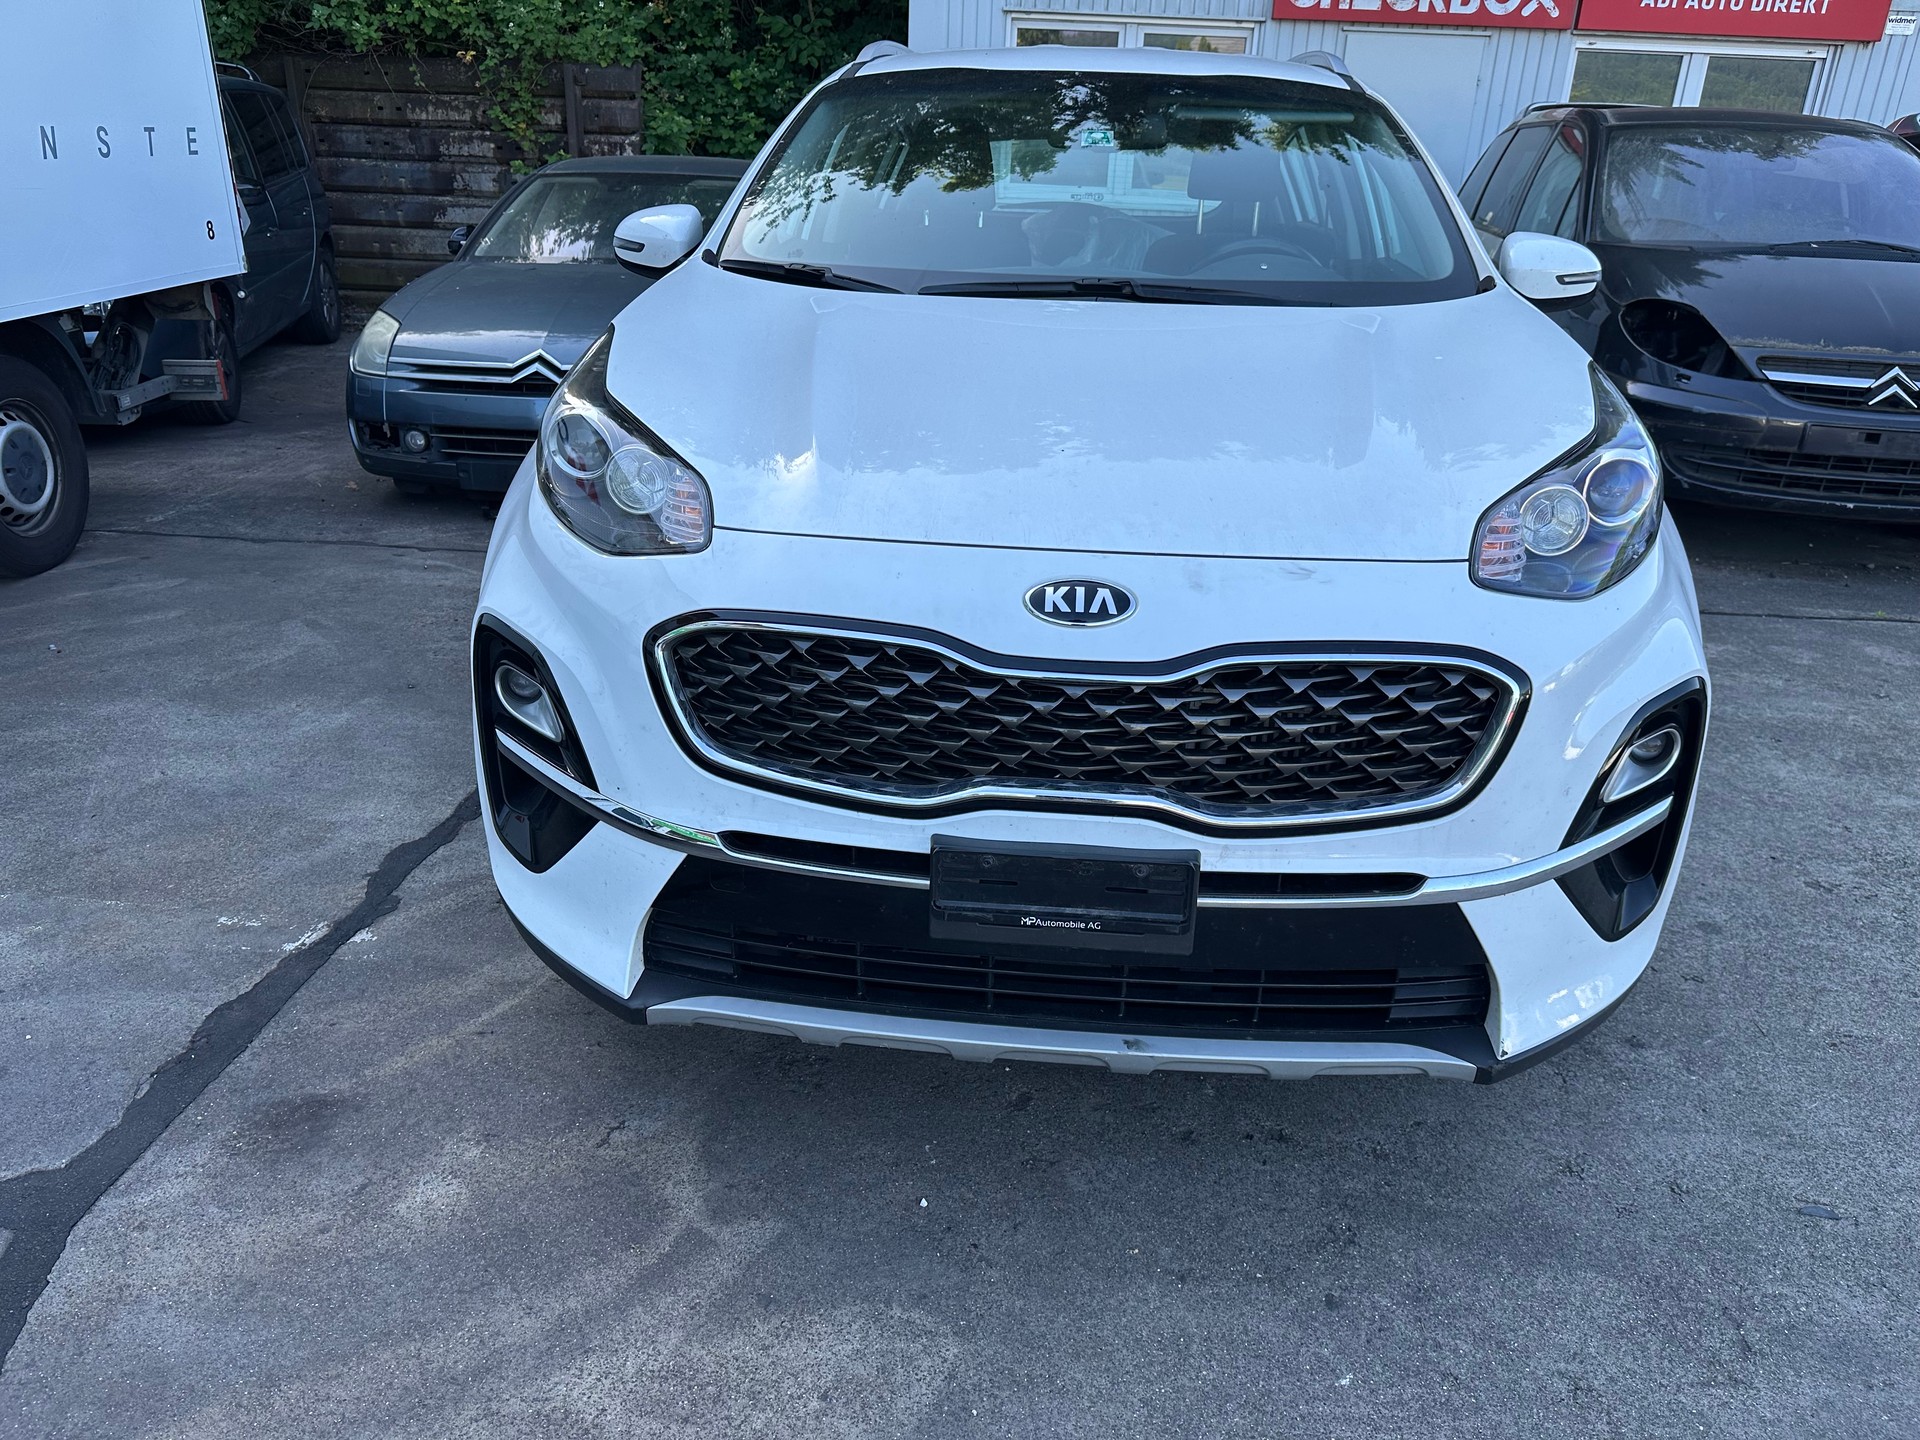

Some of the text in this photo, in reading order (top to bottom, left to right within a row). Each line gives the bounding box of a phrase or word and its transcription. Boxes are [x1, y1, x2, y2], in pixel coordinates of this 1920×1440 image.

[1750, 0, 1832, 14] DIREKT
[1888, 16, 1917, 24] widmer
[206, 220, 215, 240] 8
[1044, 586, 1118, 615] KIA
[1087, 921, 1101, 930] AG
